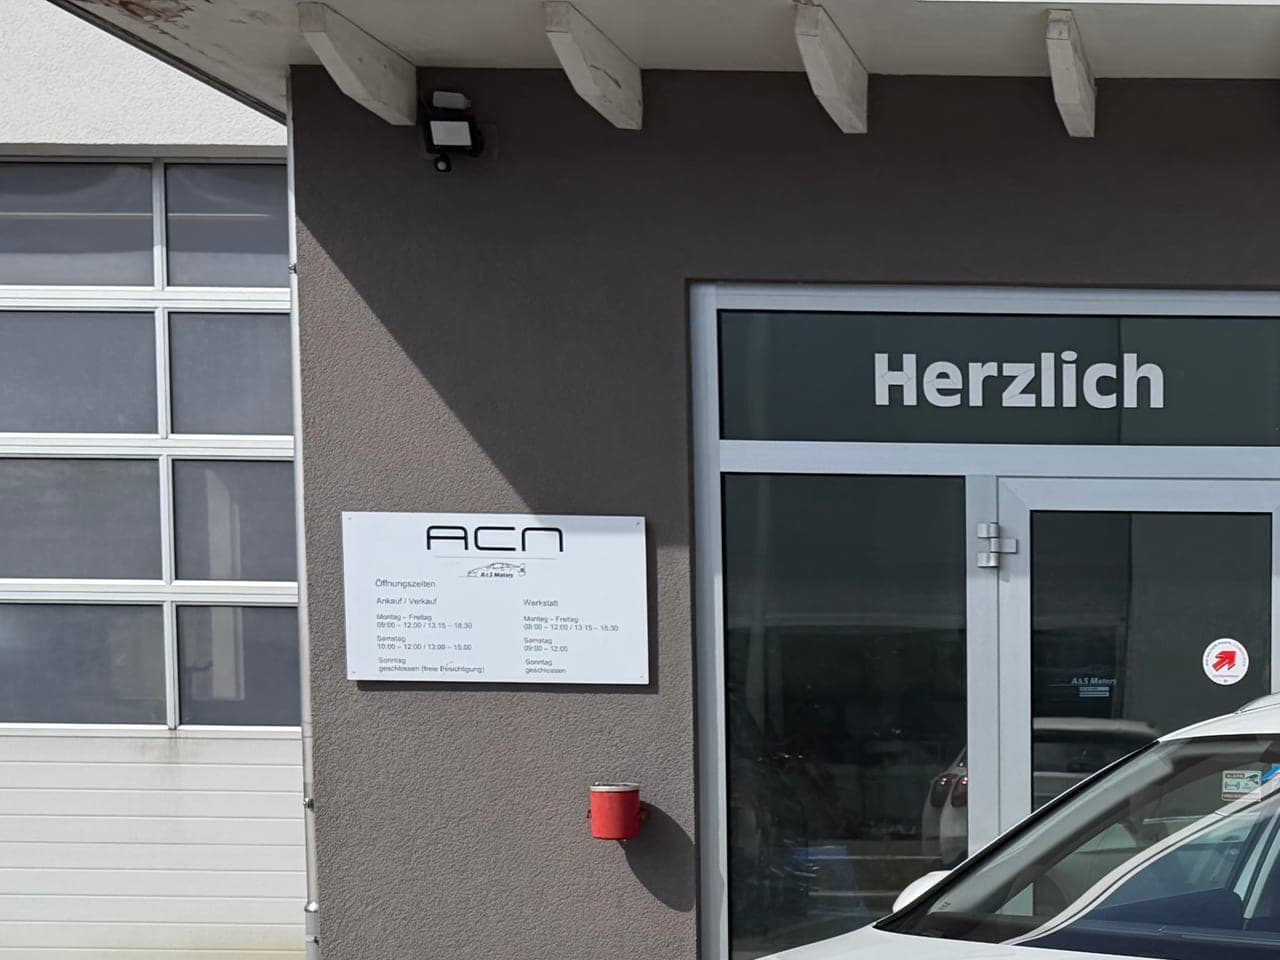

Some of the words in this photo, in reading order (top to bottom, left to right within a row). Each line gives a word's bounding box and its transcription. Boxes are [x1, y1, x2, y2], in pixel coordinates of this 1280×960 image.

[874, 350, 1164, 409] Herzlich
[375, 578, 436, 589] Öffnungszeiten
[376, 597, 402, 605] Ankauf
[523, 599, 559, 607] Werkstatt
[376, 613, 401, 621] Montag
[523, 615, 548, 623] Montag
[377, 635, 406, 643] Samstag
[523, 637, 552, 645] Samstag
[378, 657, 406, 665] Sonntag
[525, 658, 552, 666] Sonntag
[525, 667, 566, 675] geschlossen
